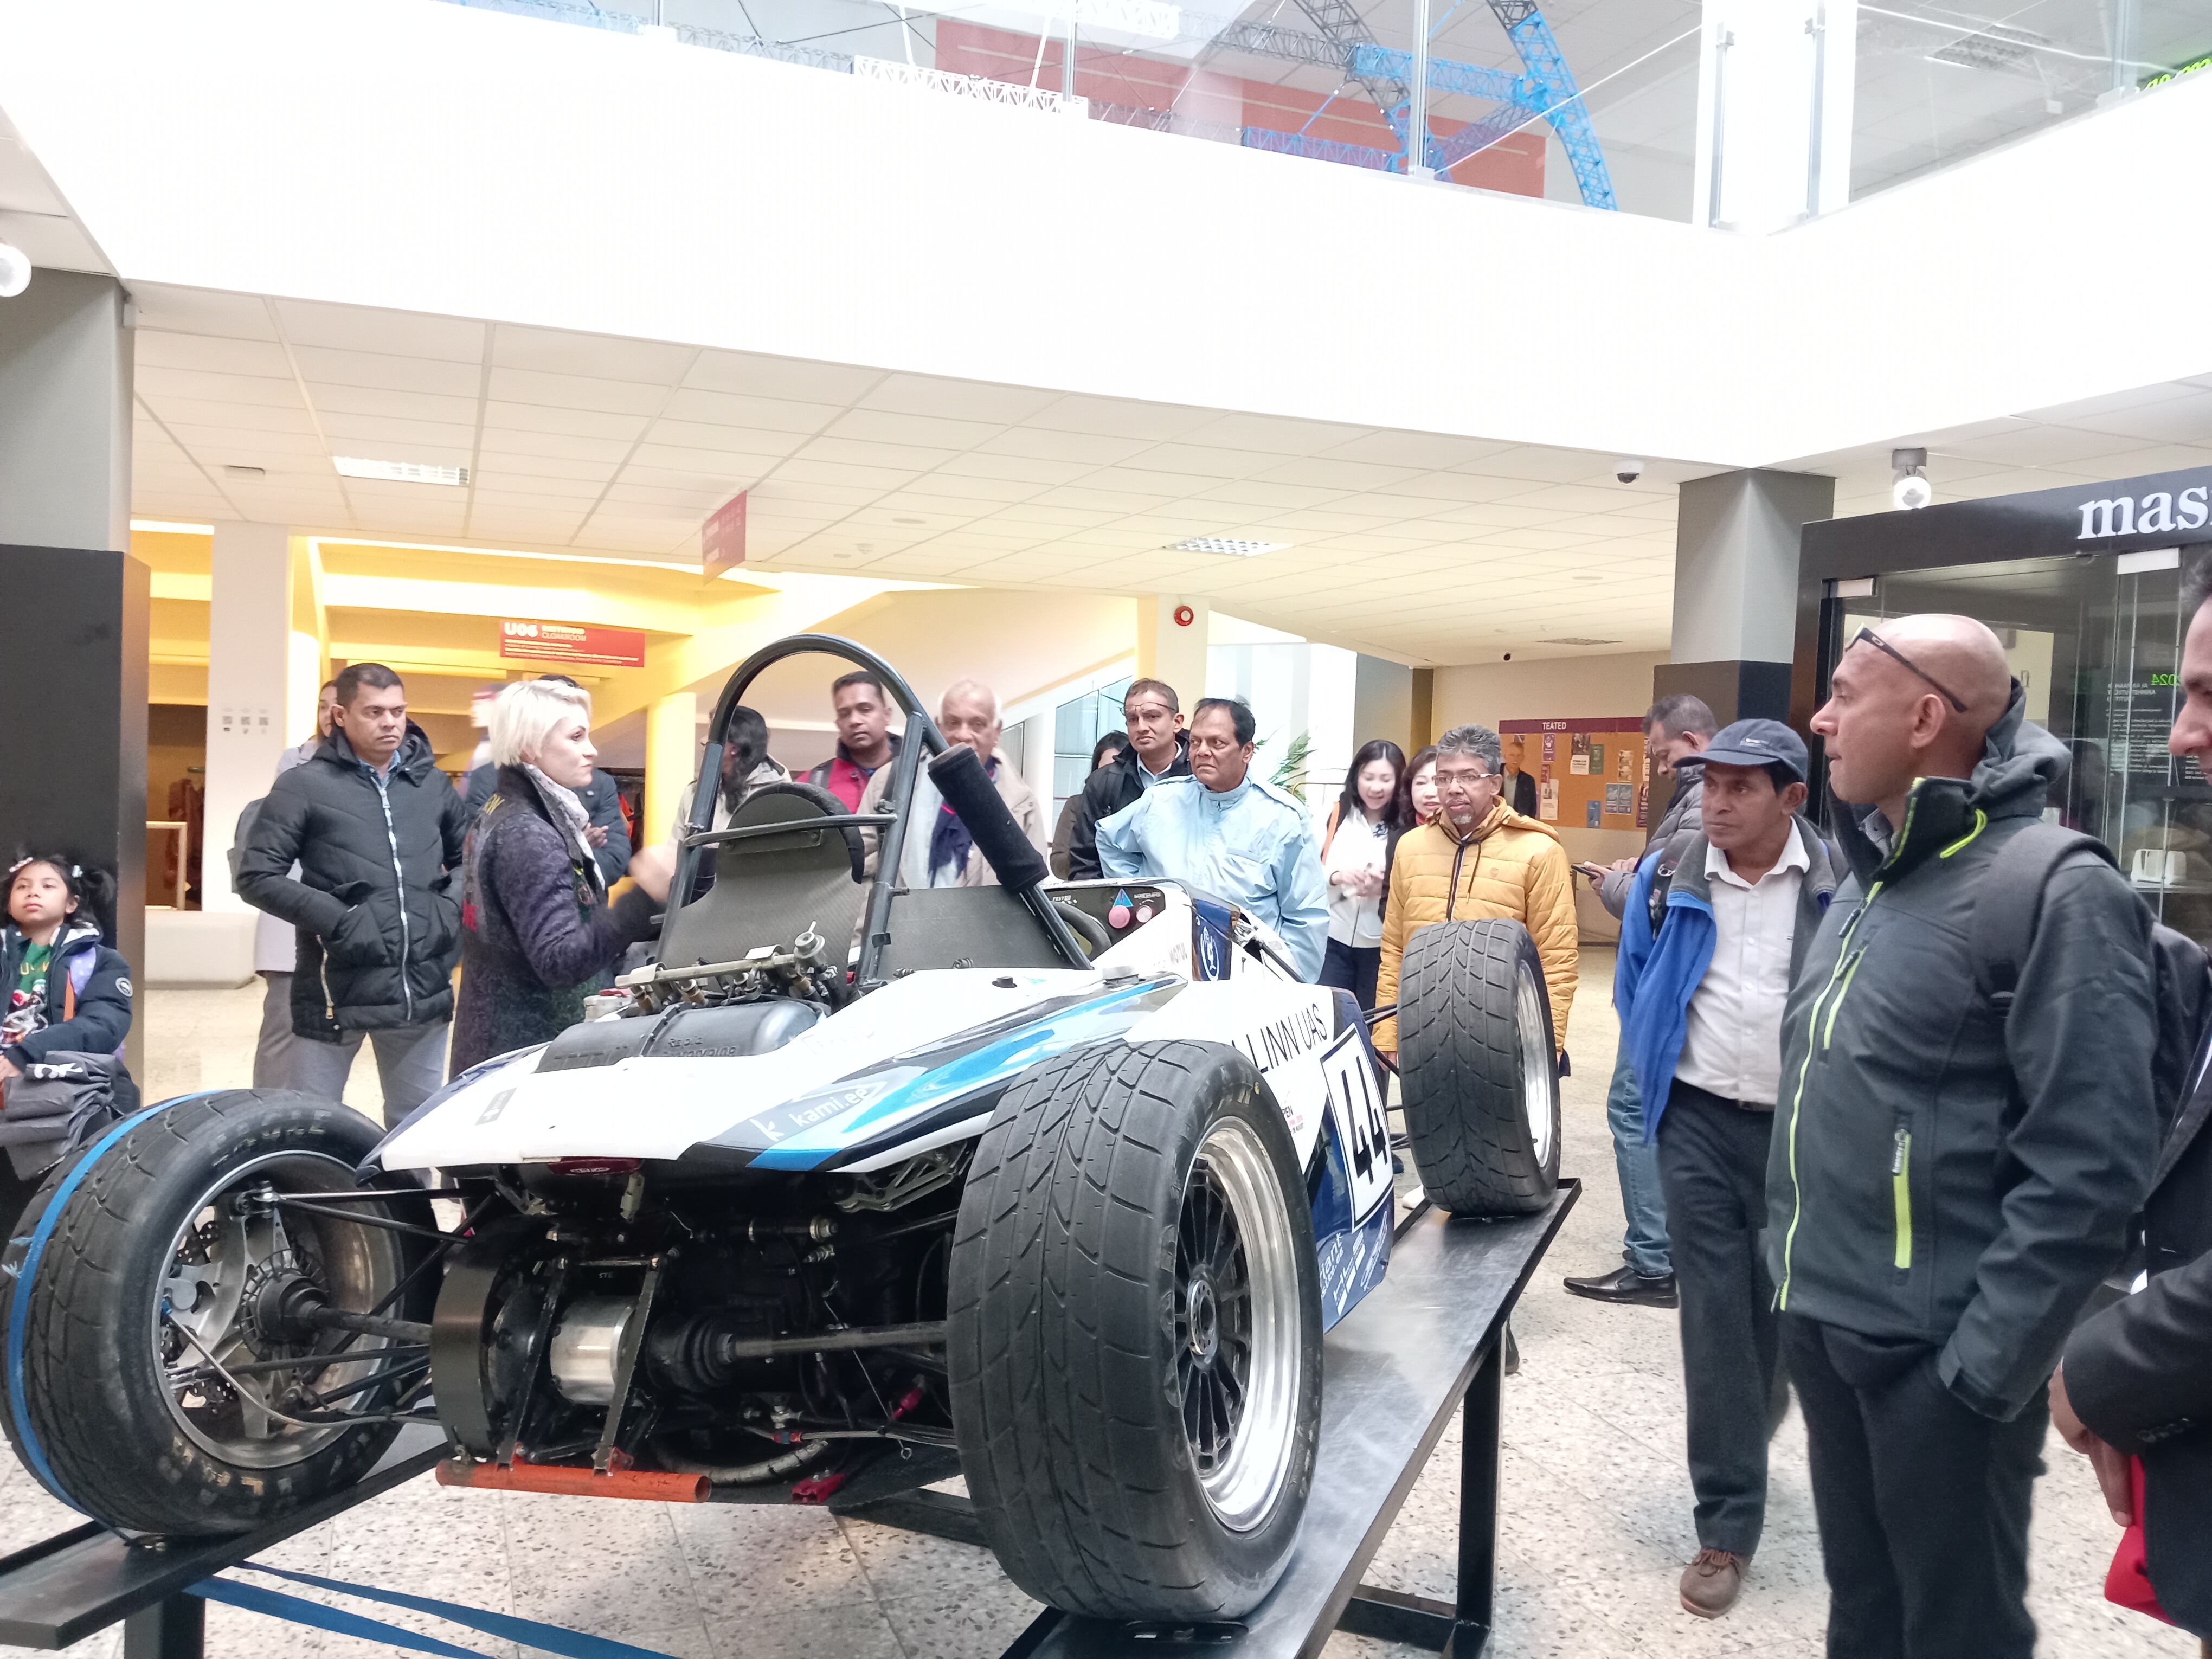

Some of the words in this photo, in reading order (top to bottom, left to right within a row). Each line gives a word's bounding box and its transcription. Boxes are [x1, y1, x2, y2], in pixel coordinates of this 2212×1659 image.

[2076, 486, 2212, 540] mas
[542, 632, 587, 642] CLOAKROOM
[1542, 722, 1567, 730] TEATED
[1231, 1019, 1300, 1075] LINN
[1295, 1003, 1327, 1050] UAS
[788, 1088, 868, 1127] kami.ee
[1281, 1105, 1294, 1118] PEN
[1341, 1056, 1388, 1185] 44
[1320, 1232, 1342, 1280] riant
